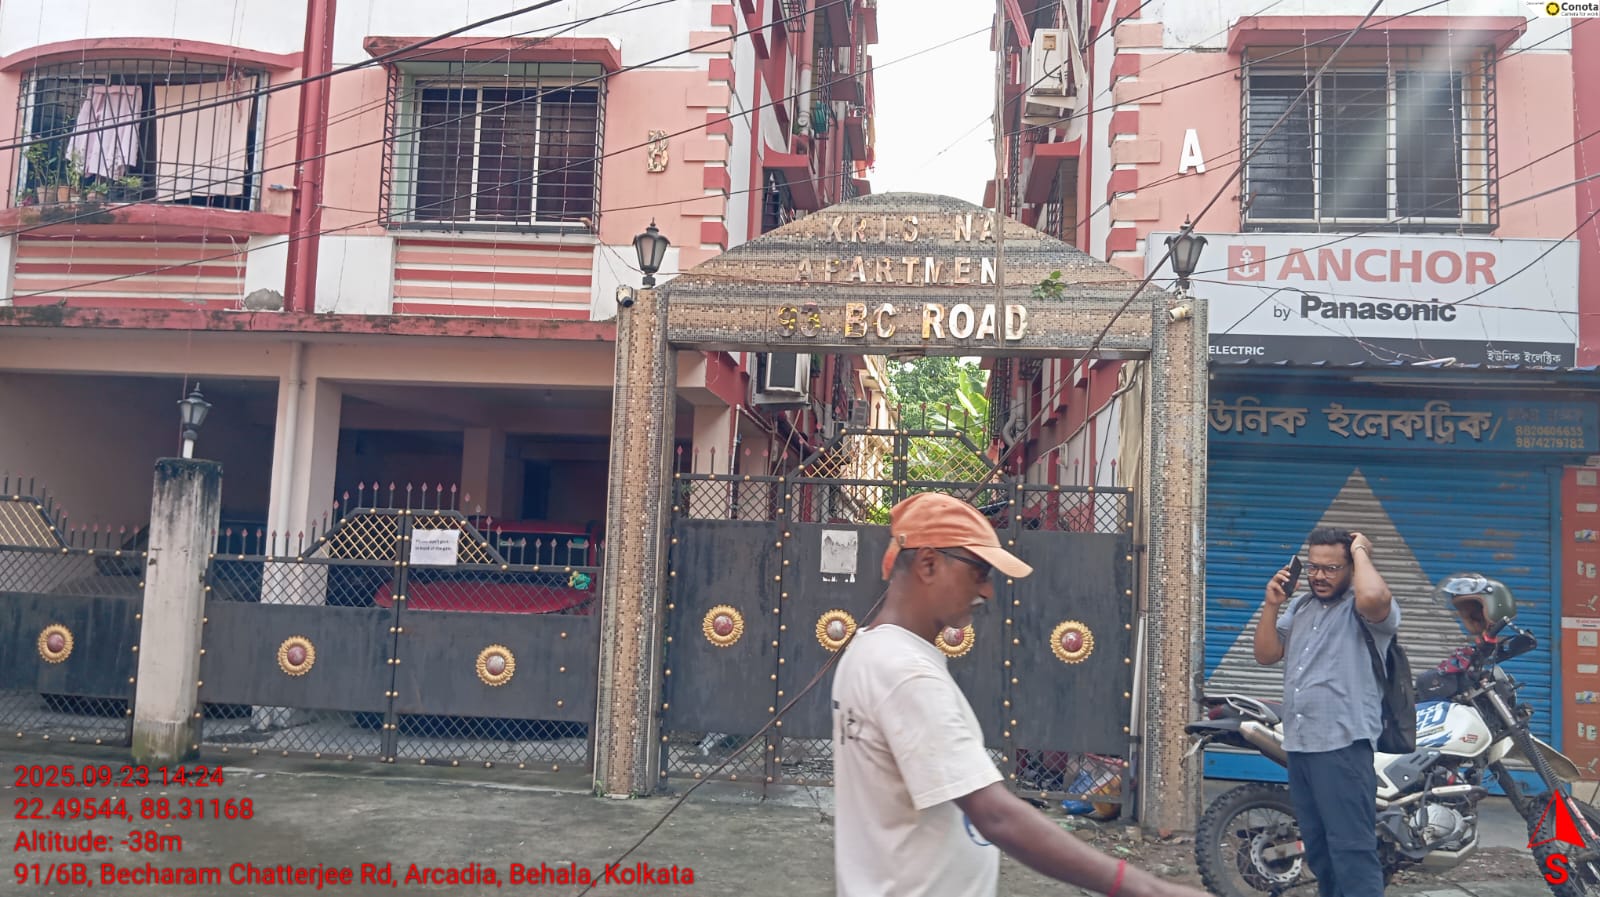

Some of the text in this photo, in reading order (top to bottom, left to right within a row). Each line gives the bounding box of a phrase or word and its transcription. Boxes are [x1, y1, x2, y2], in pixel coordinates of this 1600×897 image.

[1179, 129, 1205, 174] A
[1277, 248, 1497, 285] ANCHOR
[776, 303, 1028, 340] 93 BC ROAD
[1273, 295, 1457, 322] by Panasonic
[1208, 345, 1265, 355] ELECTRIC
[1207, 396, 1308, 435] উনিক
